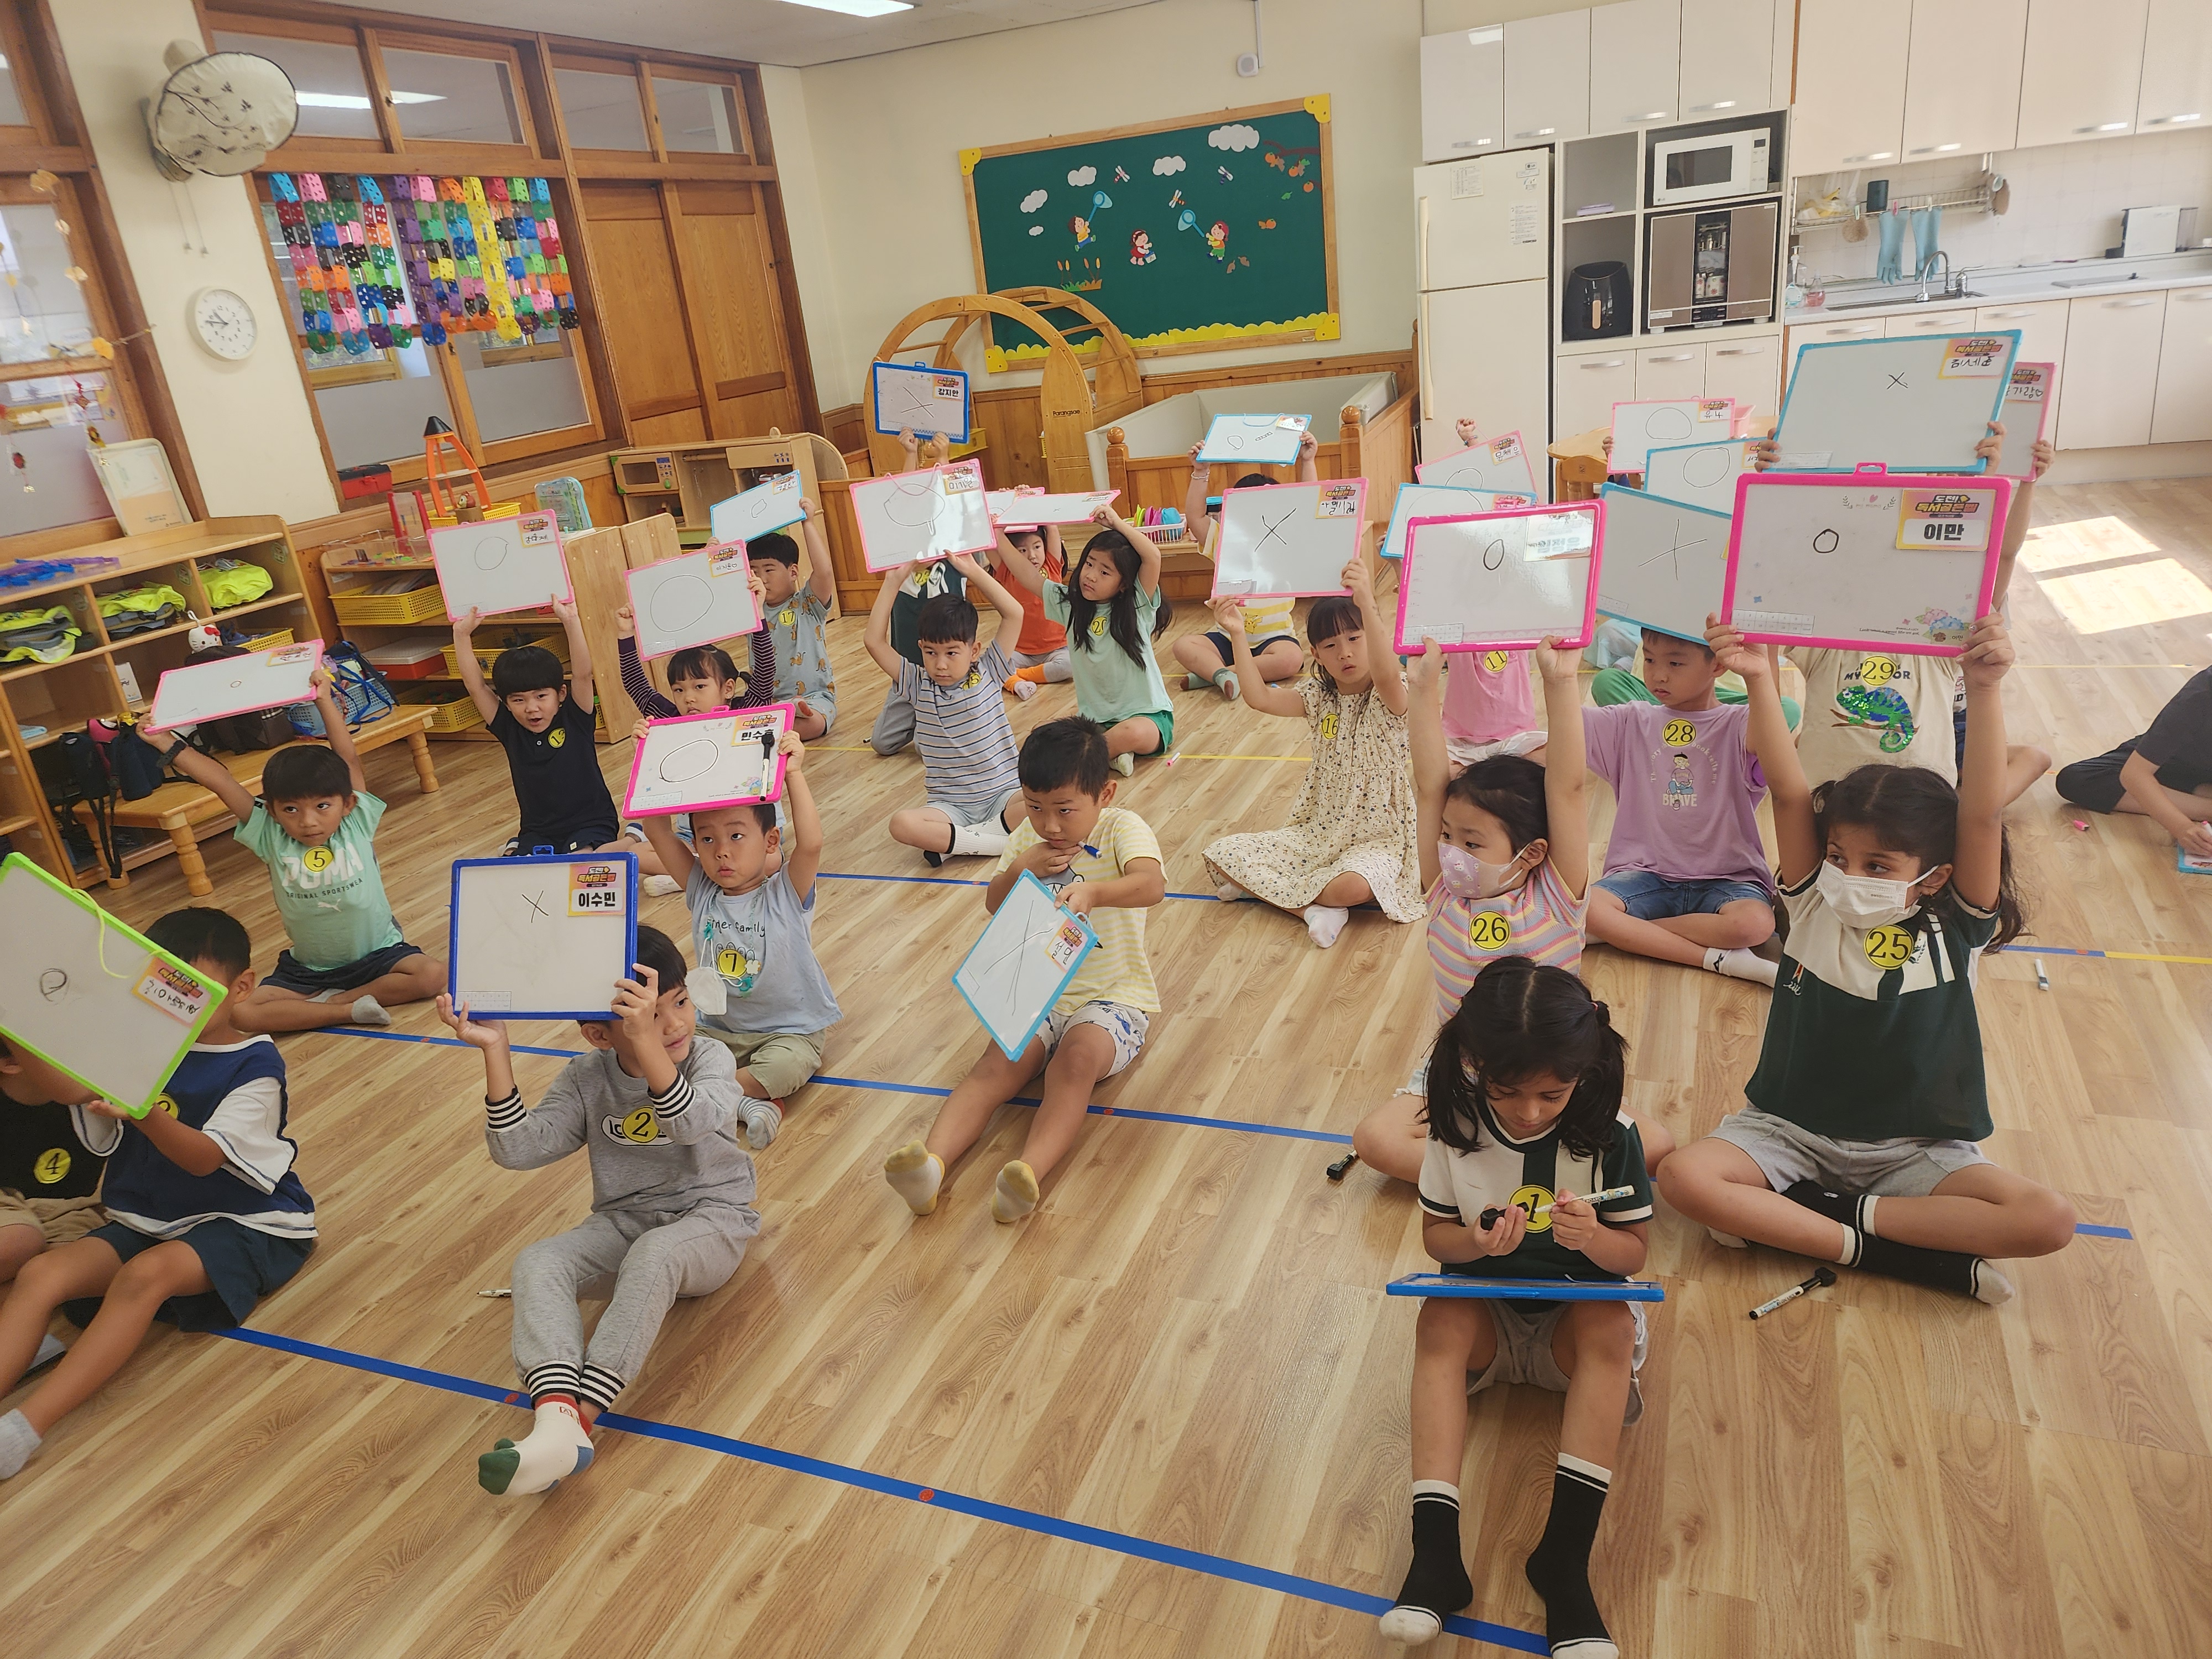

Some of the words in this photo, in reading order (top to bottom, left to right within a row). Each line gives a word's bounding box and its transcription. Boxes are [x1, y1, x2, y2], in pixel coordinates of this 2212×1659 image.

[1923, 523, 1965, 541] 이만
[781, 611, 795, 623] 17
[1485, 651, 1507, 670] 11
[1863, 660, 1895, 680] 29
[1325, 717, 1338, 736] 16
[1667, 724, 1693, 743] 28
[312, 851, 325, 868] 5
[322, 878, 363, 896] SPORTSWEA
[578, 891, 616, 907] 이수민
[735, 921, 766, 938] family
[1473, 917, 1507, 942] 26
[1869, 931, 1910, 961] 25
[725, 953, 737, 972] 7
[632, 1112, 651, 1138] 2
[44, 1152, 61, 1175] 4
